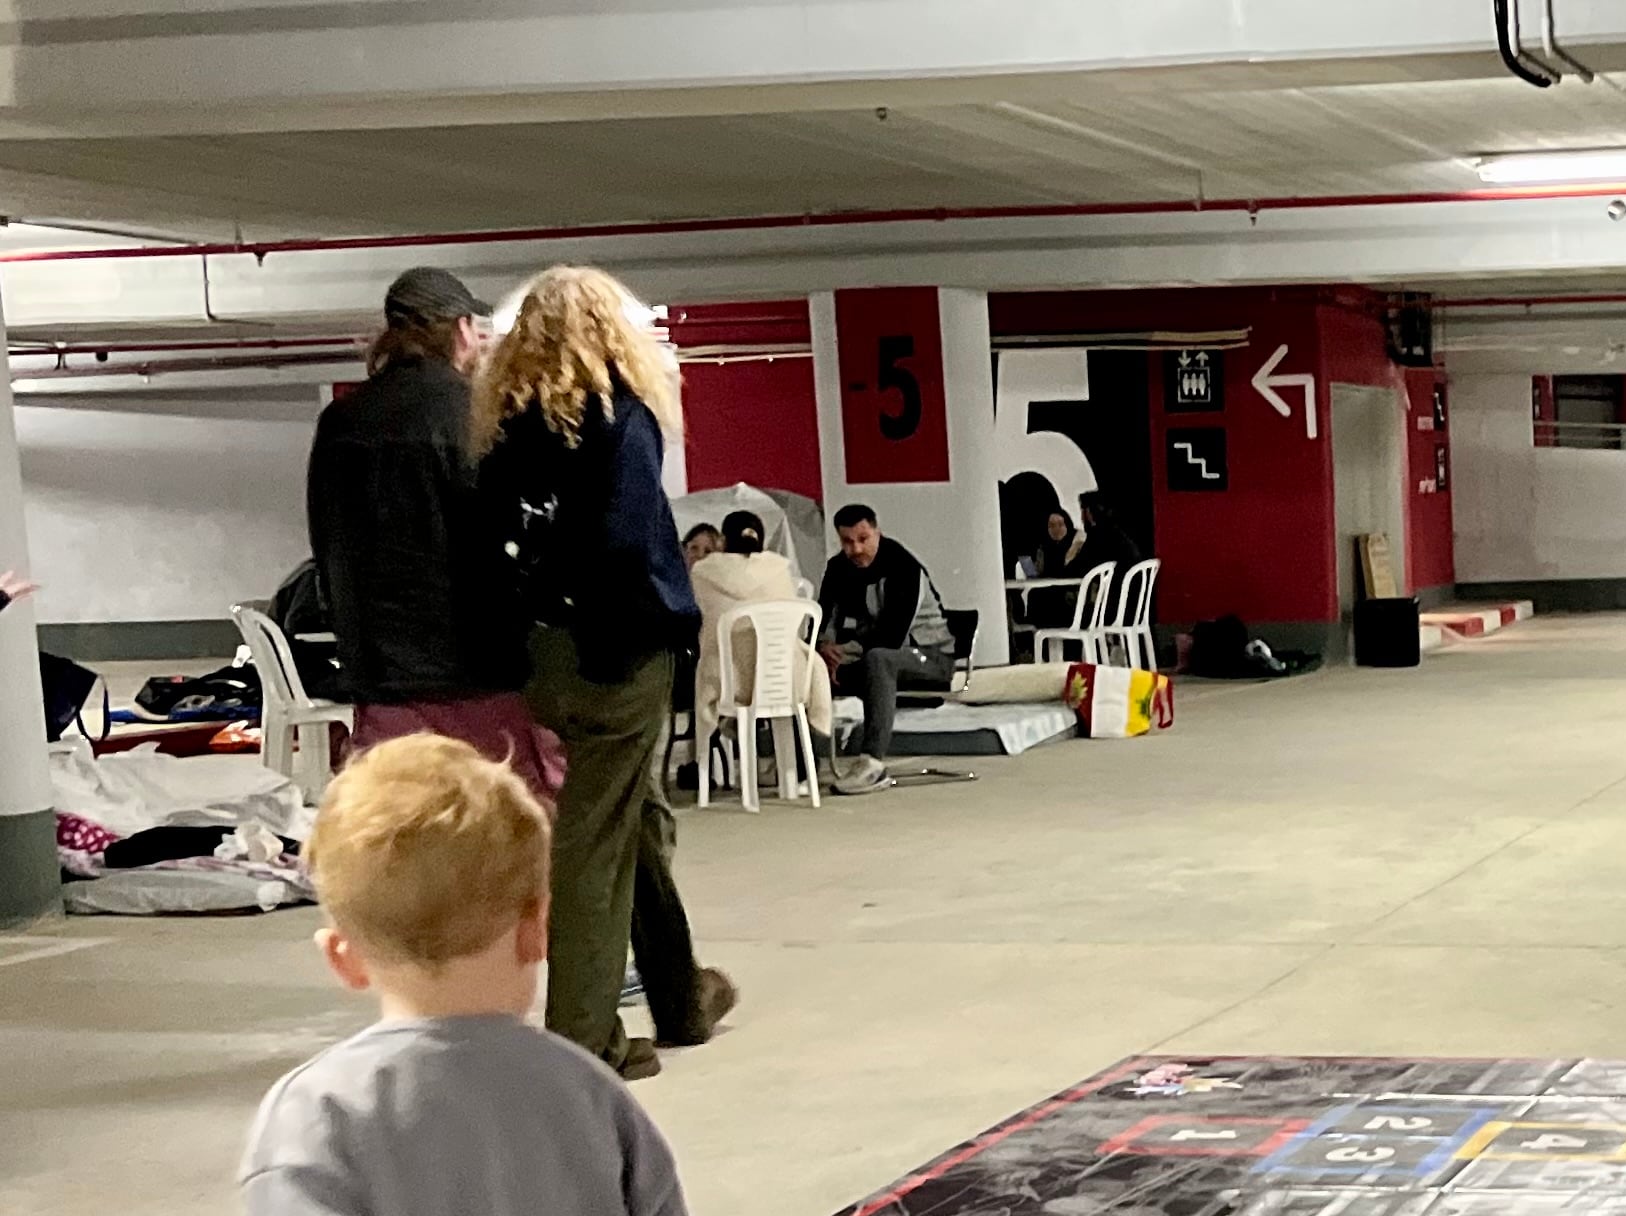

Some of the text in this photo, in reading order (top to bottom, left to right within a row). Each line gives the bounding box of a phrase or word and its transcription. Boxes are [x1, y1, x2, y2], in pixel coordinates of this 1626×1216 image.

[847, 334, 924, 441] -5
[1363, 1115, 1433, 1131] 2
[1169, 1128, 1237, 1141] 1
[1519, 1133, 1588, 1150] 4
[1325, 1146, 1396, 1162] 3
